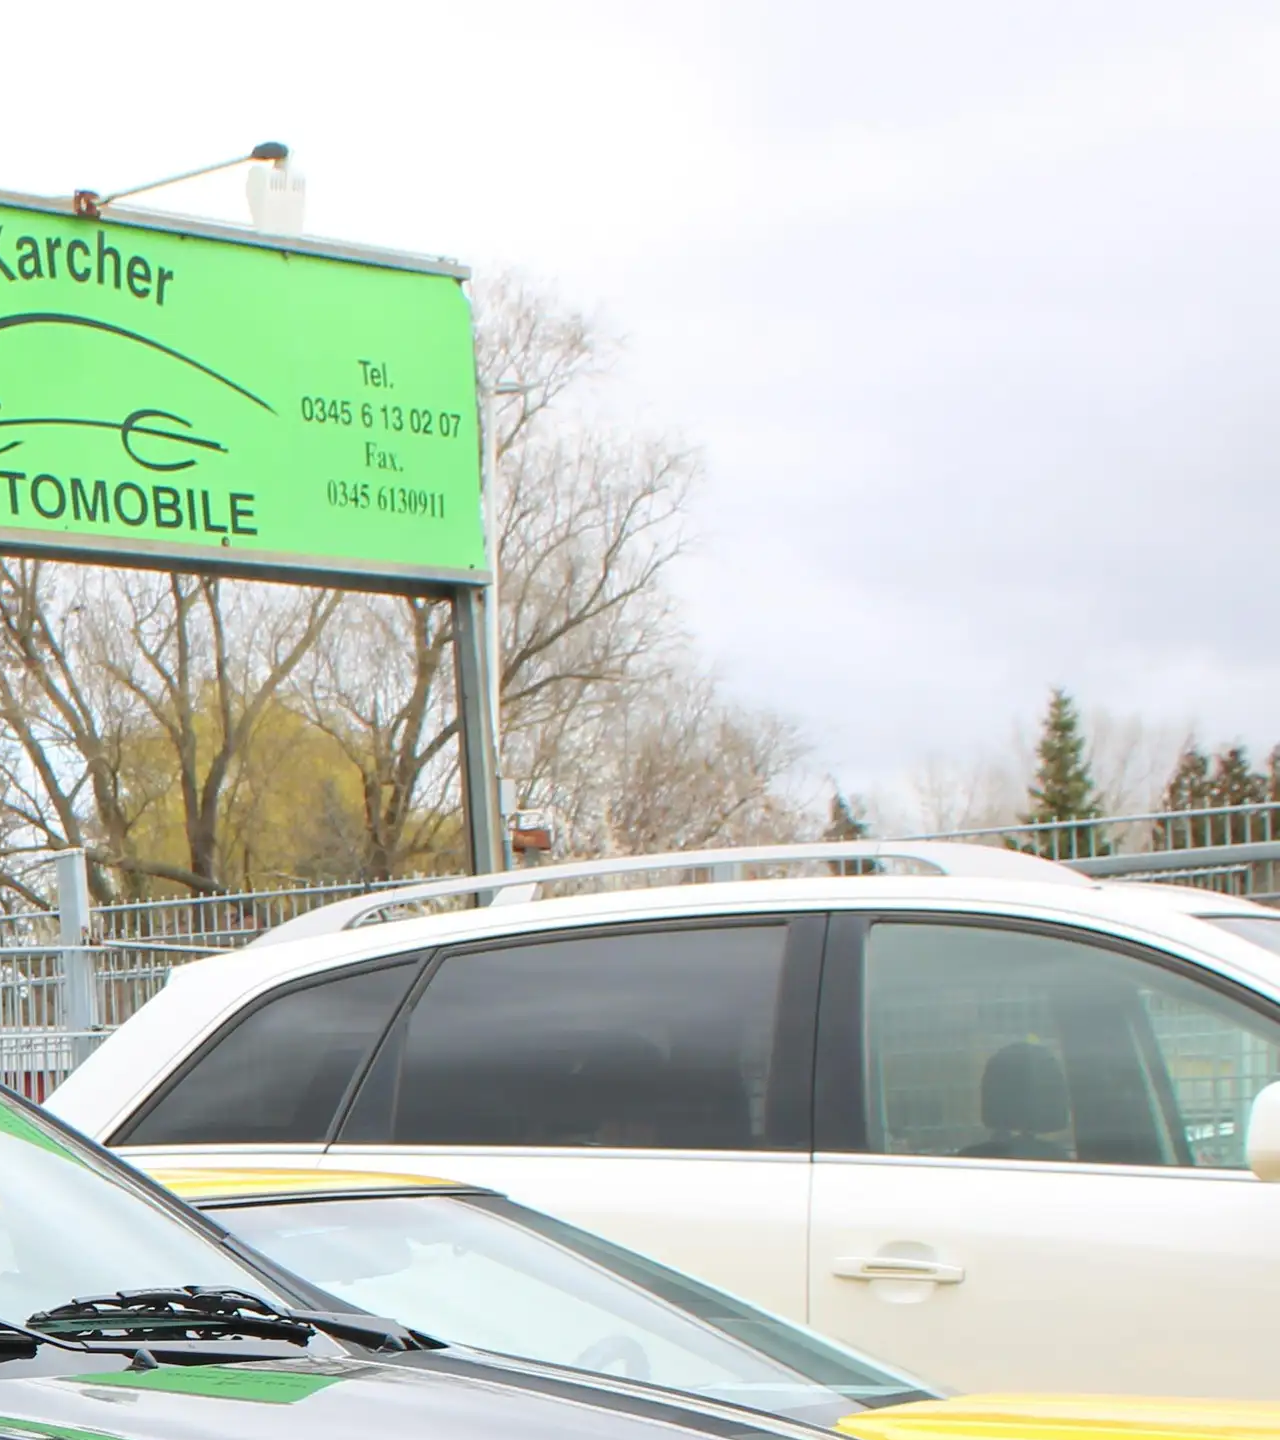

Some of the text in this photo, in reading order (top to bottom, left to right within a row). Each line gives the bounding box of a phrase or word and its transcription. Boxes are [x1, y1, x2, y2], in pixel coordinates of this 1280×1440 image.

[357, 359, 394, 389] Tel.
[301, 396, 461, 438] 0345 6 13 02 07
[365, 441, 404, 472] Fax.
[327, 479, 445, 519] 0345 6130911
